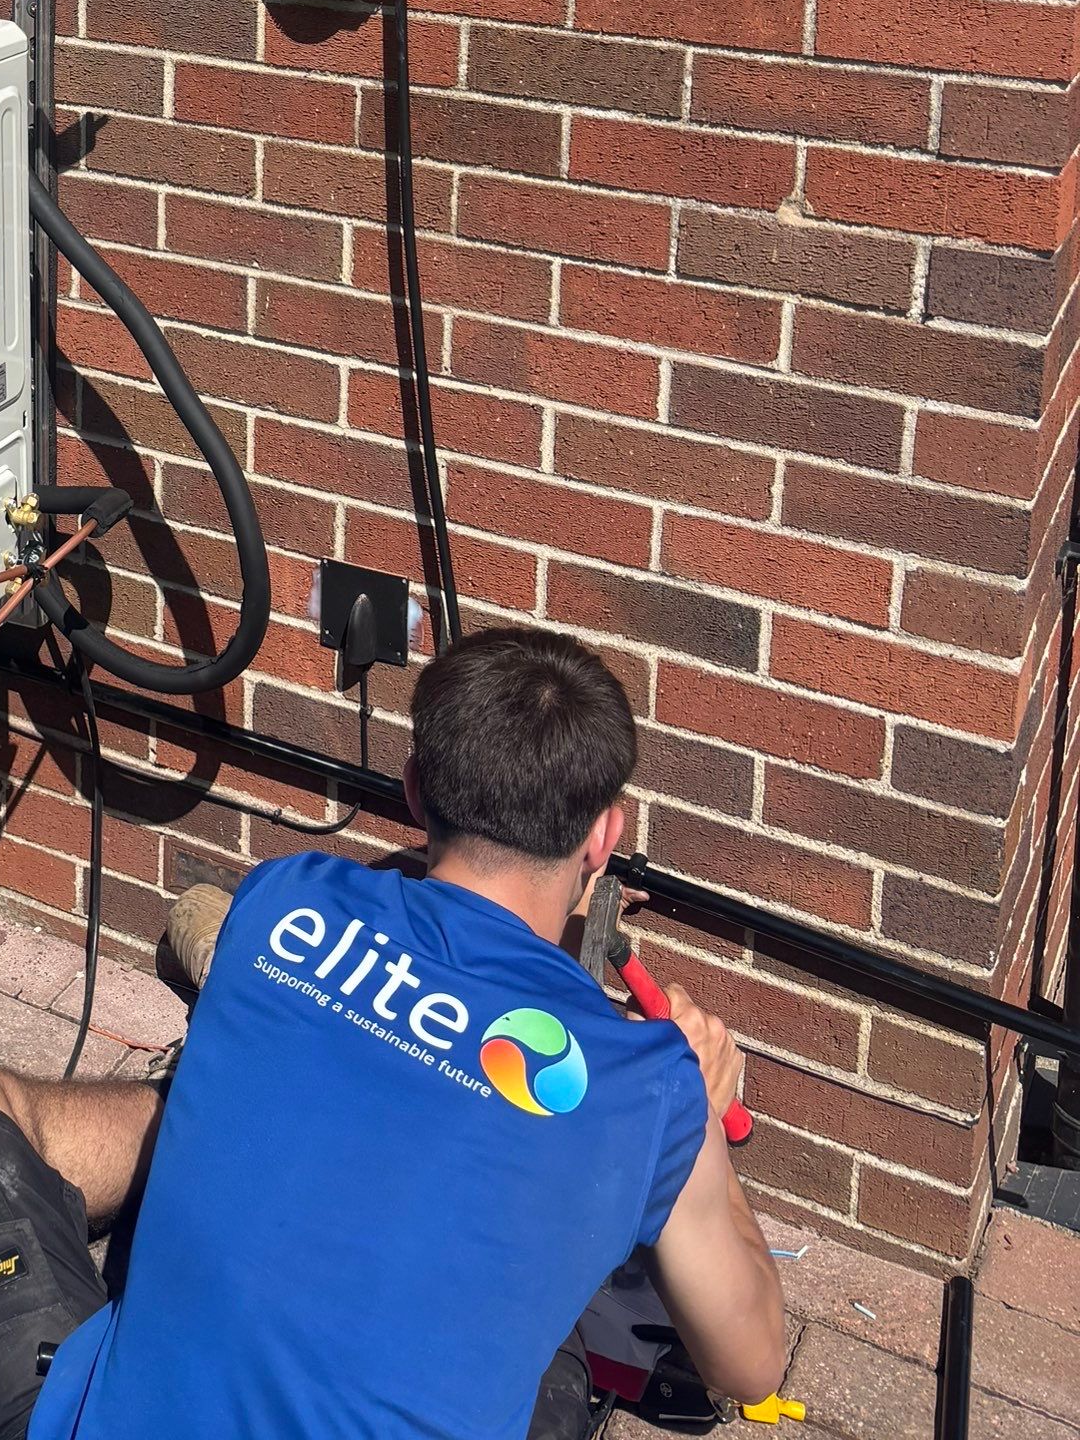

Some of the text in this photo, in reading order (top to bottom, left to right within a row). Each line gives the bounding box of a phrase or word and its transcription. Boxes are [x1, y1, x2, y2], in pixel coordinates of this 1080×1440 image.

[253, 955, 492, 1098] Supporting a sustainable future
[269, 907, 469, 1050] elite
